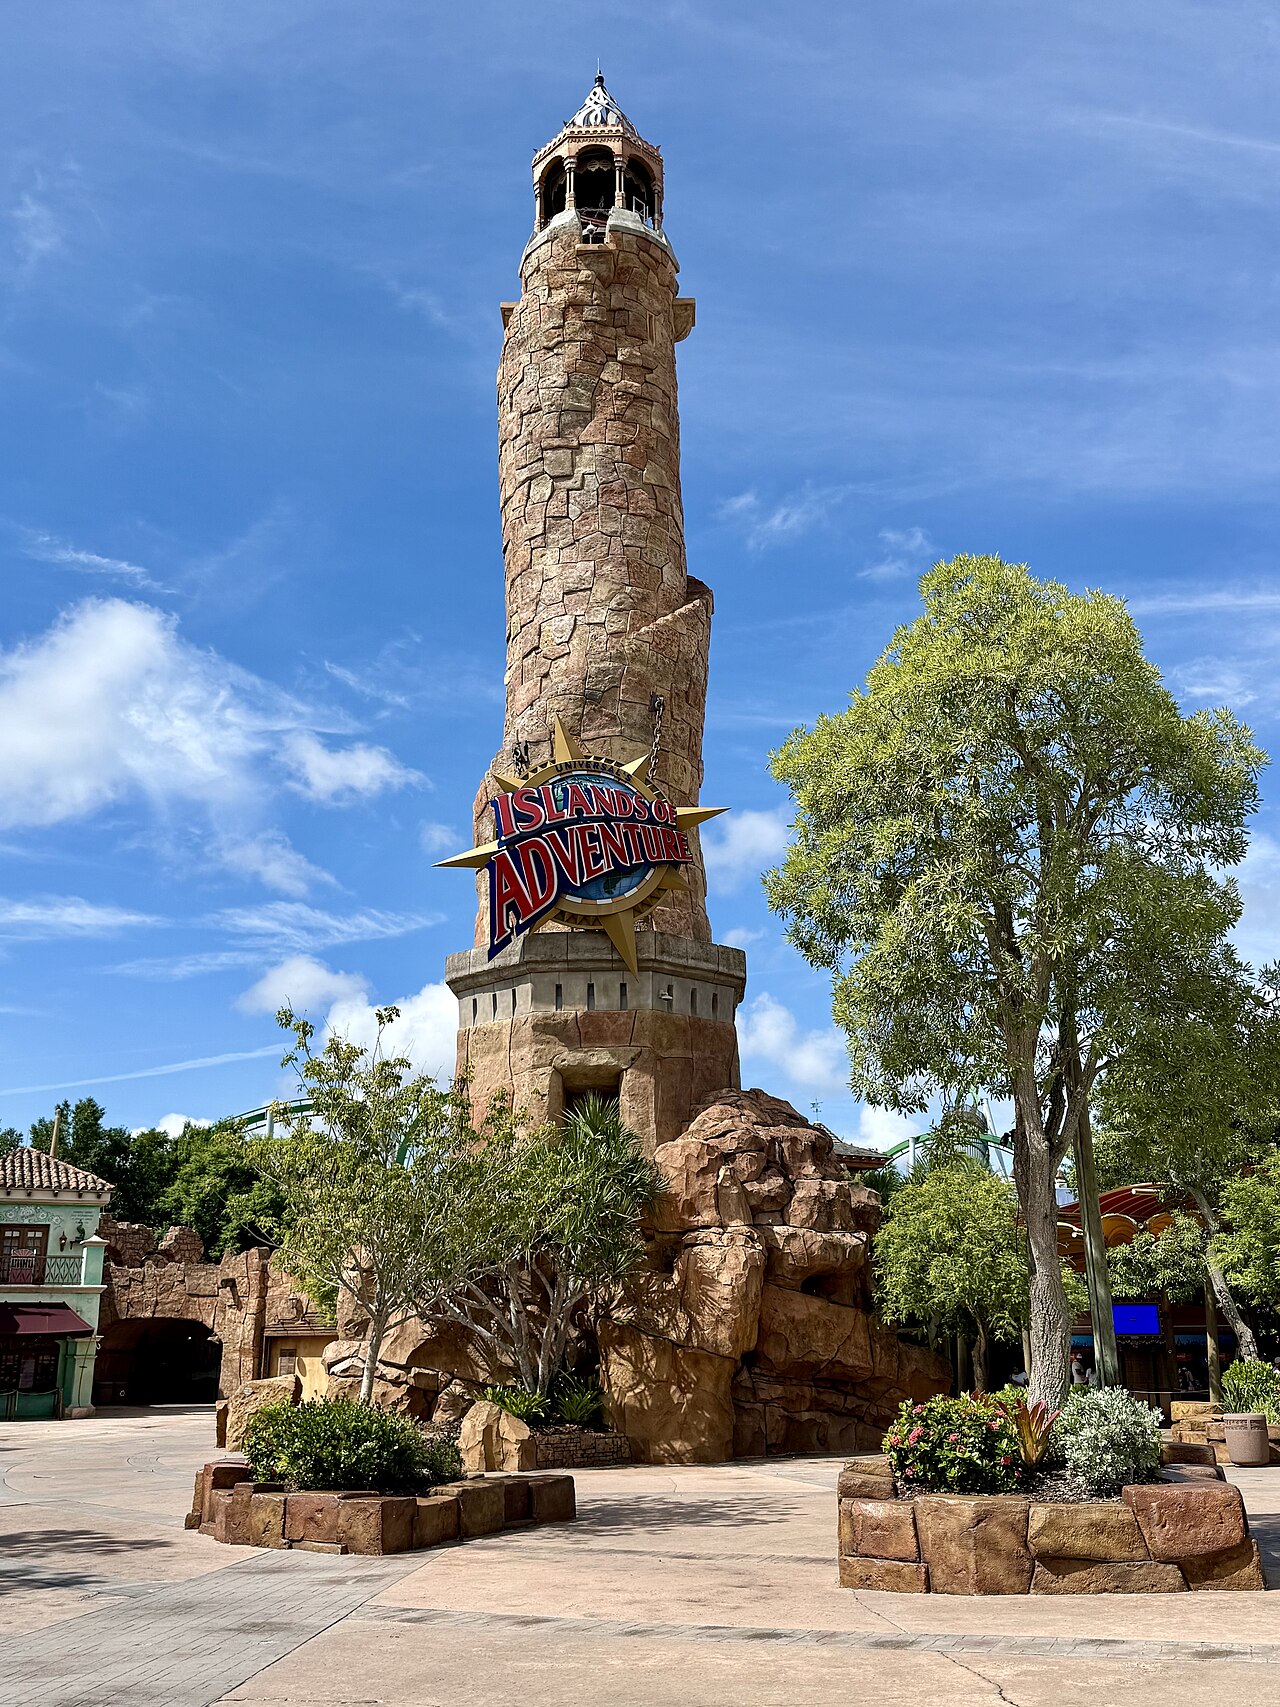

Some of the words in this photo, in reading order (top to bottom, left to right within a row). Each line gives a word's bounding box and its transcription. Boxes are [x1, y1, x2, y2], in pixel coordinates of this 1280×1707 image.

[555, 760, 632, 782] UNIVERSAL'S
[493, 784, 648, 840] ISLANDS
[651, 798, 677, 826] OF
[491, 822, 693, 945] ADVENTURE
